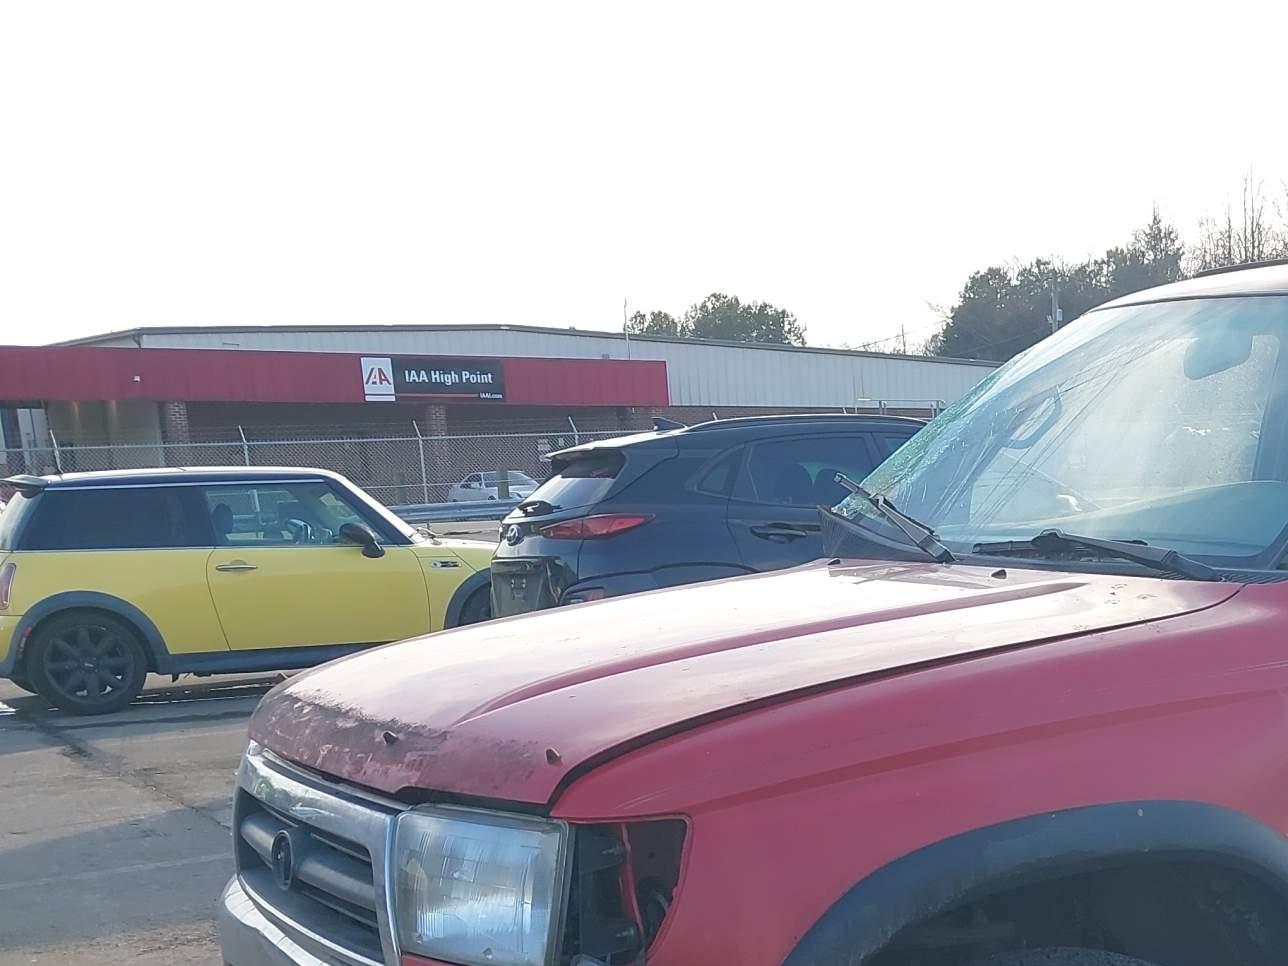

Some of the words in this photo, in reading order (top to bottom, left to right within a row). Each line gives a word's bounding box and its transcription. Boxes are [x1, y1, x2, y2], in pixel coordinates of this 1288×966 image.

[404, 370, 429, 383] IAA
[431, 370, 459, 386] High
[462, 371, 493, 384] Point
